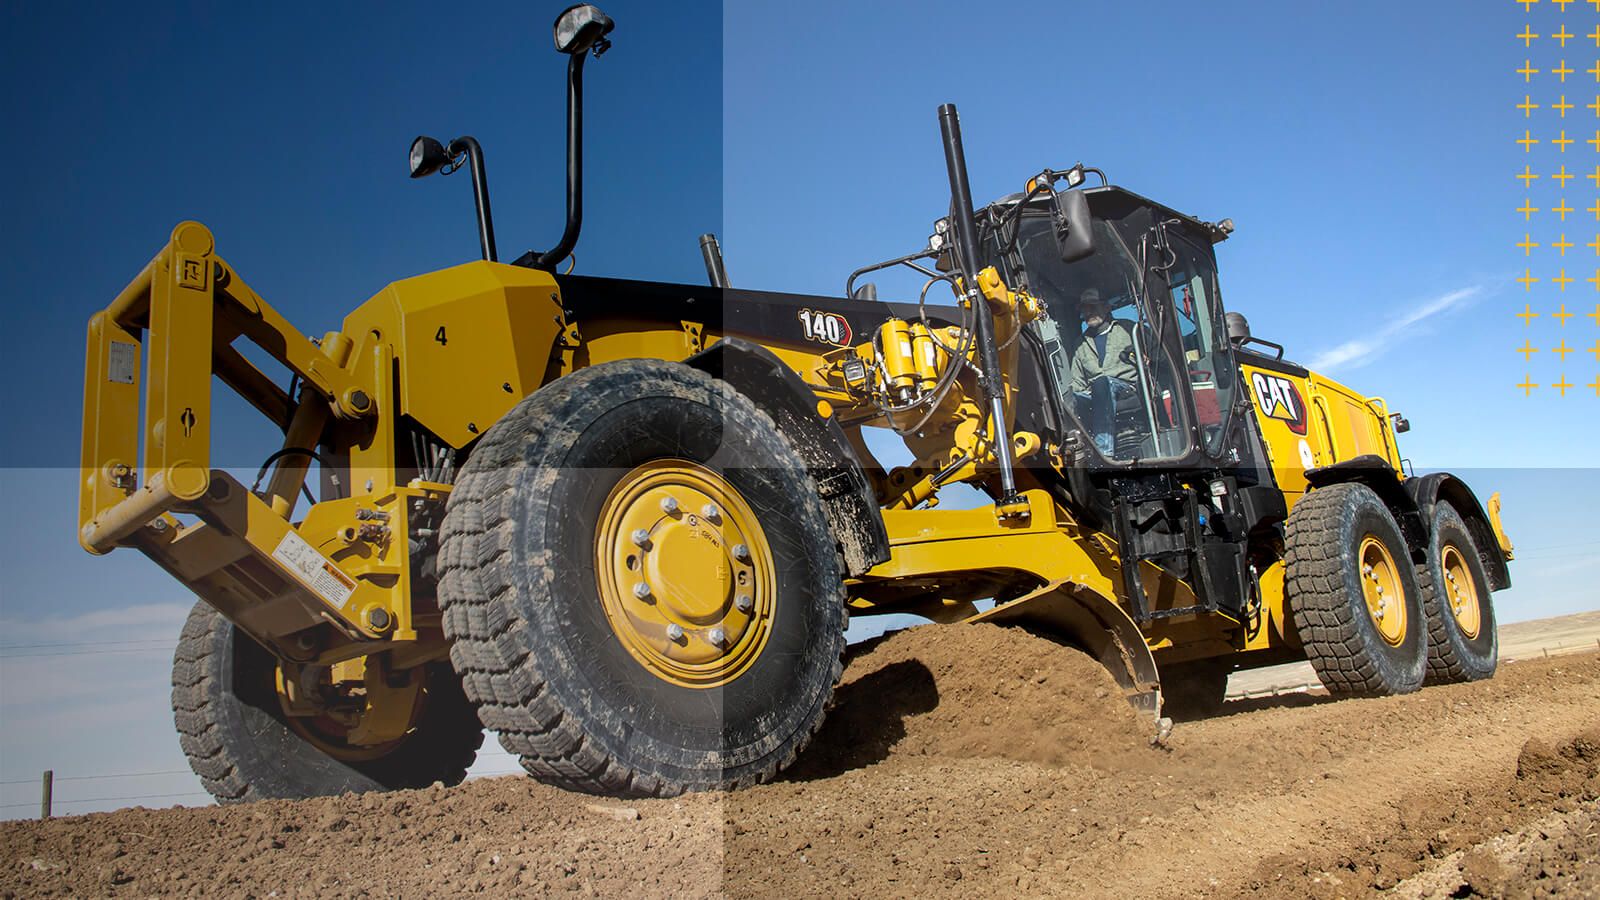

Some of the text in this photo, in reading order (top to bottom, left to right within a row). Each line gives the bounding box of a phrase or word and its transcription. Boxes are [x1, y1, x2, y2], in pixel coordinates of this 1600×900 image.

[435, 326, 448, 346] 4
[800, 311, 840, 343] 140
[1252, 373, 1298, 421] CAT
